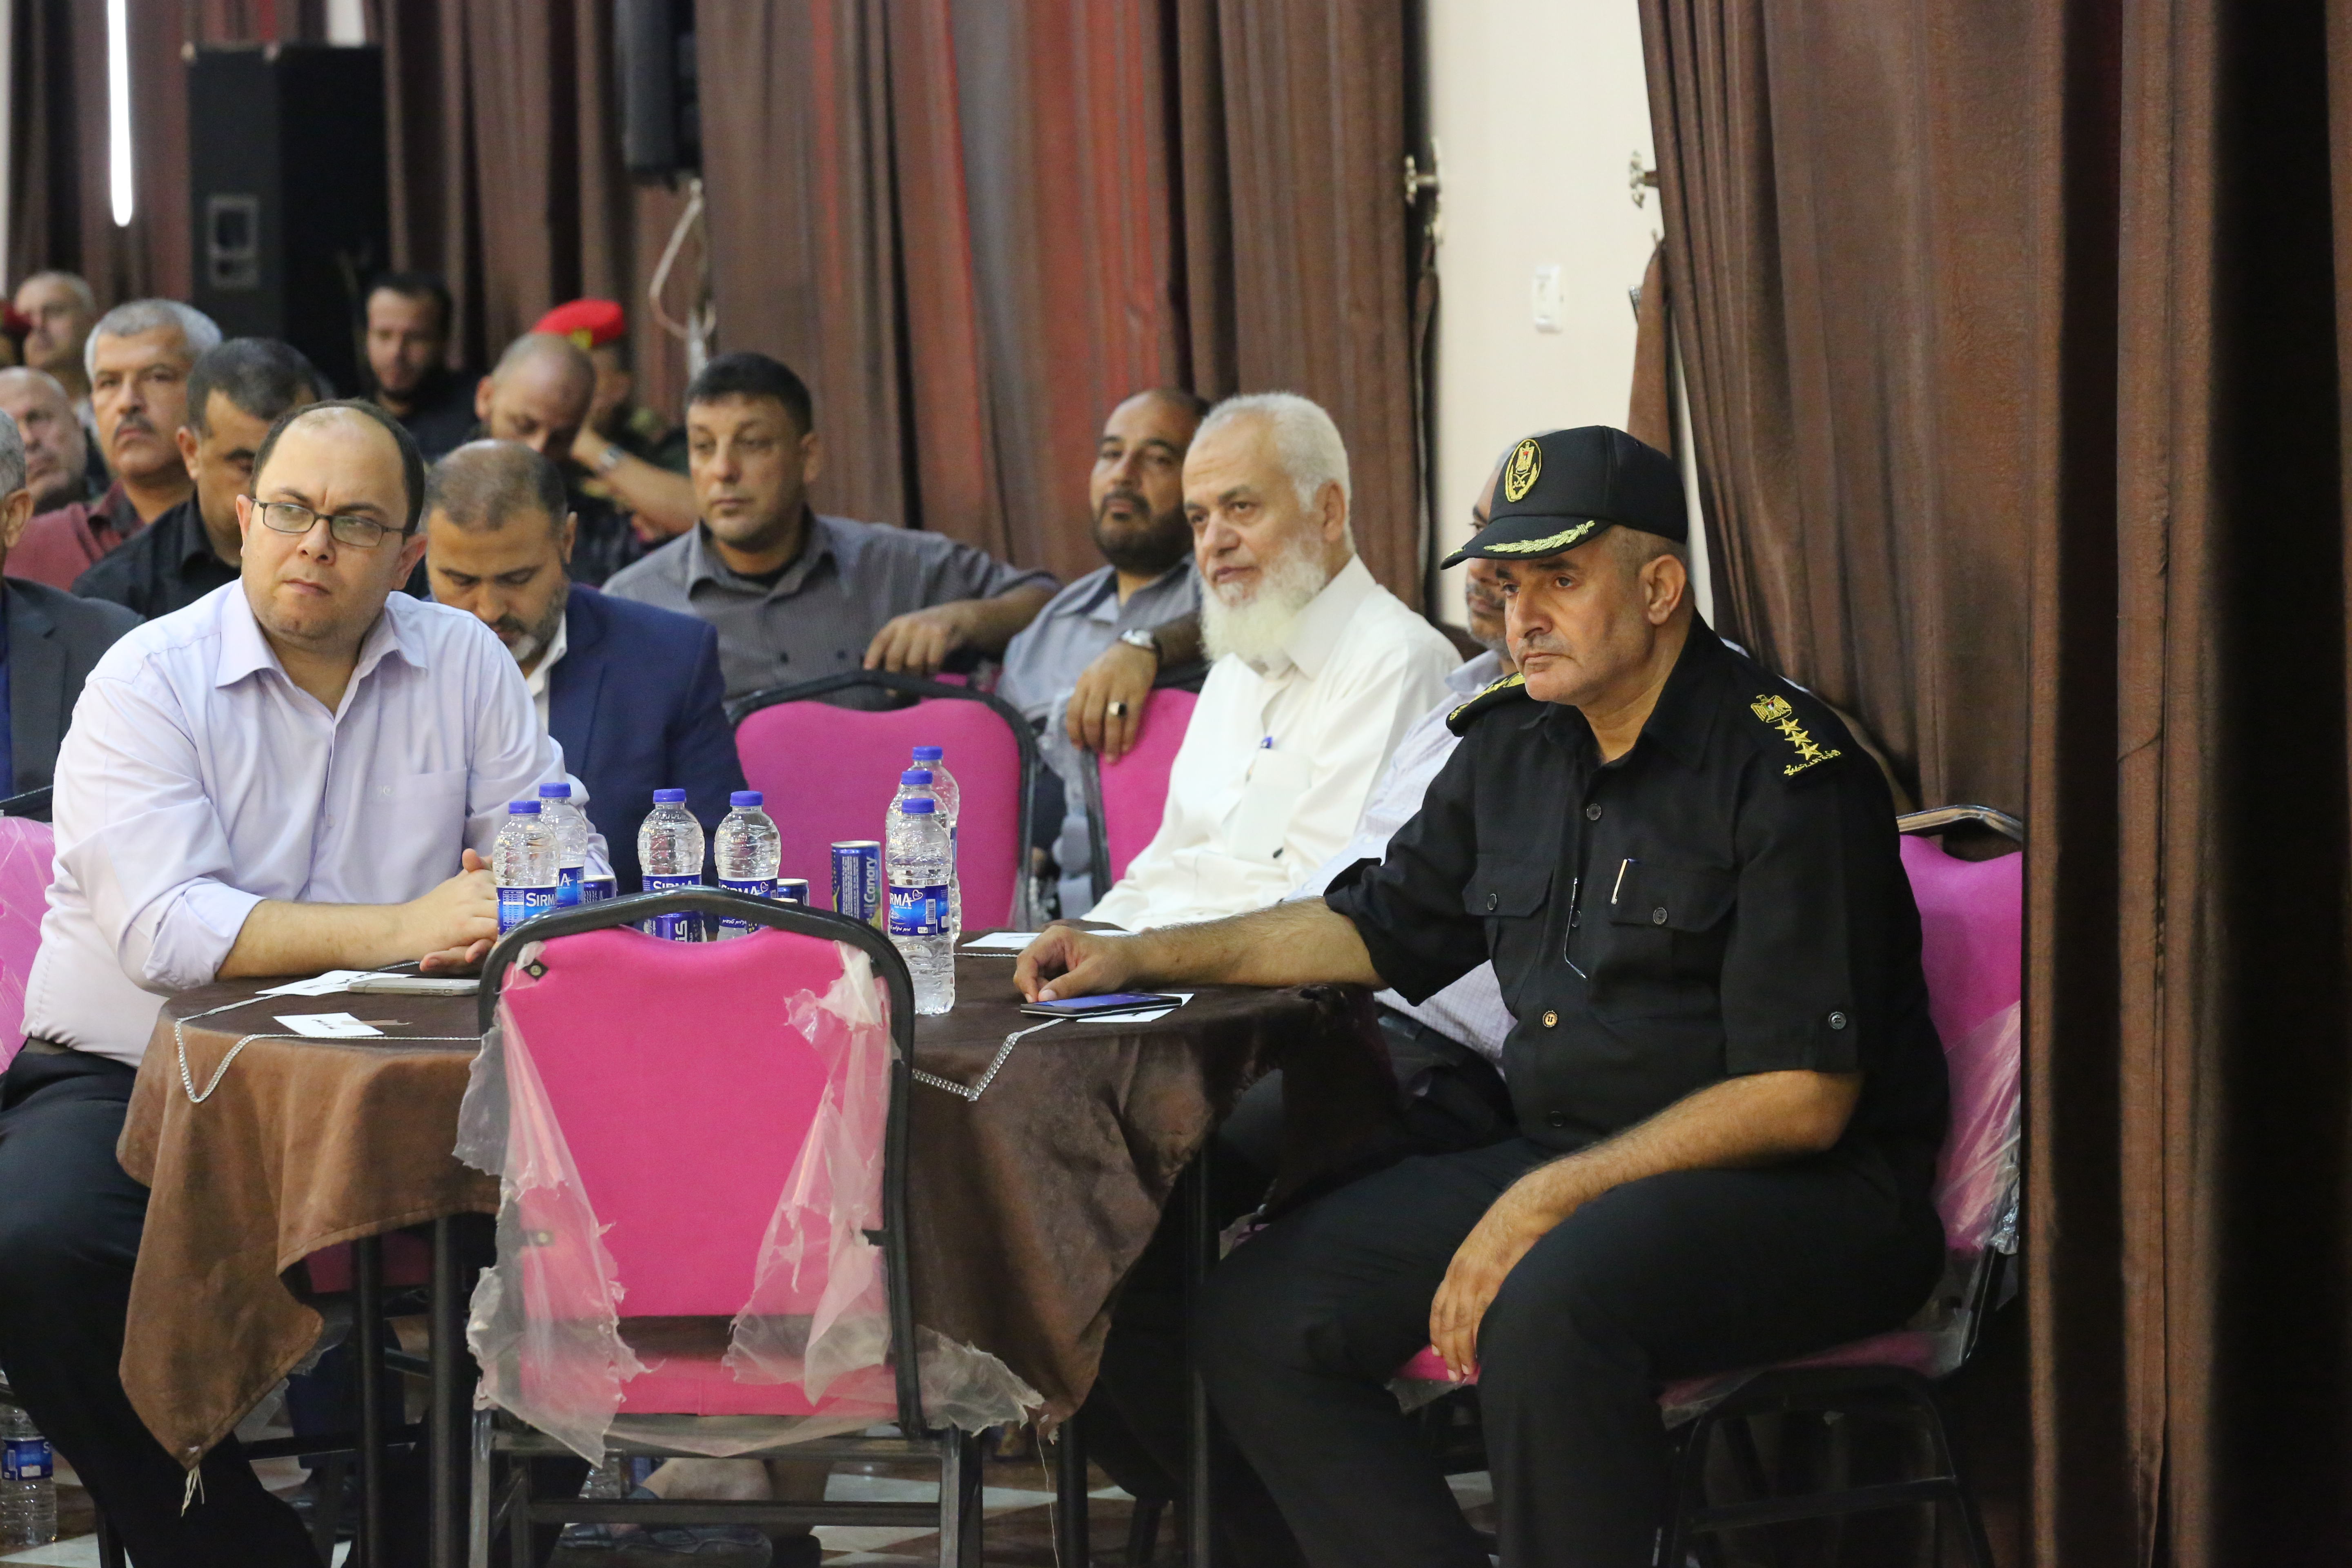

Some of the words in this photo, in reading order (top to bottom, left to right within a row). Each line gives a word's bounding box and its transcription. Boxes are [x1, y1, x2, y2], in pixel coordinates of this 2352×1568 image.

[1818, 750, 1841, 760] وزارة
[1783, 758, 1822, 775] الداخلية
[864, 856, 877, 903] Canary
[526, 892, 556, 907] SIRM
[890, 893, 916, 906] RMA
